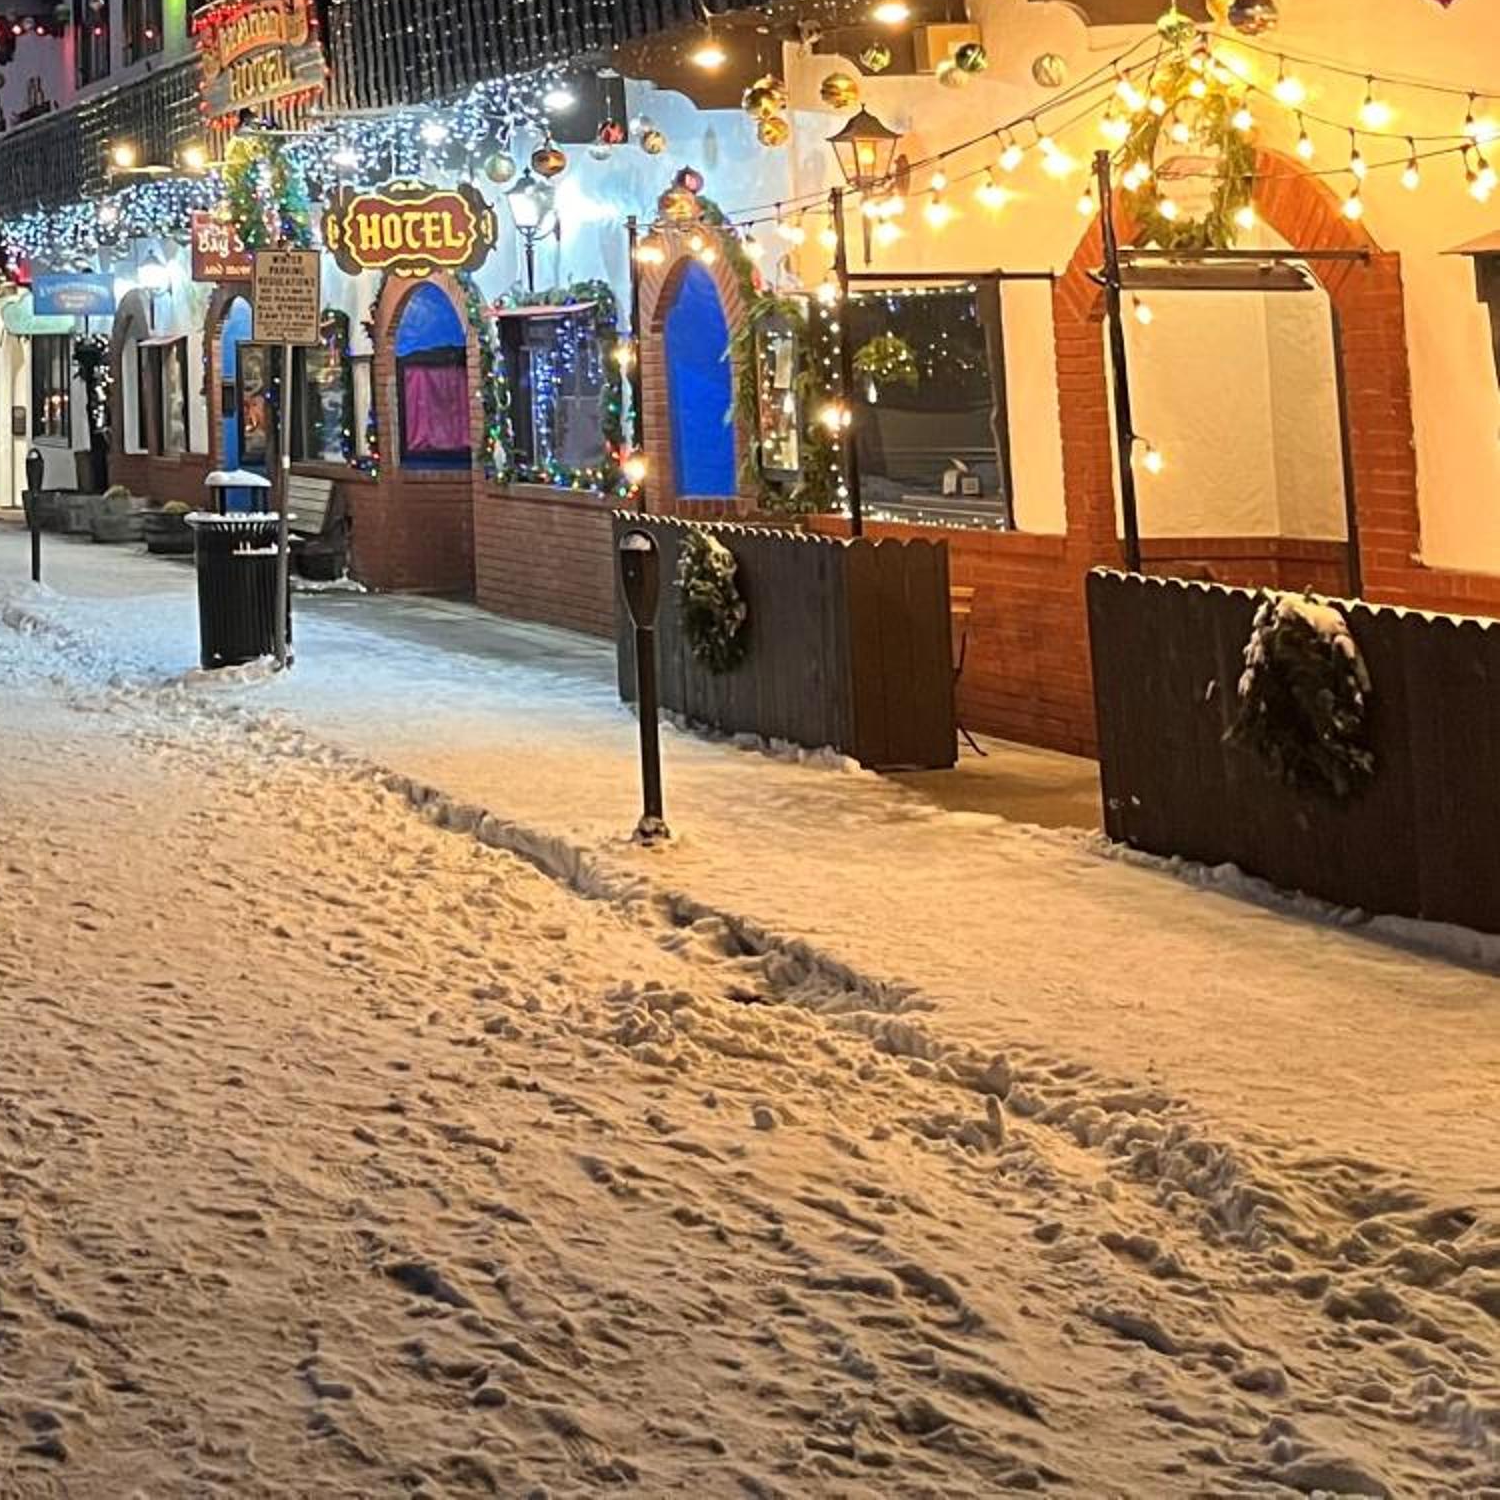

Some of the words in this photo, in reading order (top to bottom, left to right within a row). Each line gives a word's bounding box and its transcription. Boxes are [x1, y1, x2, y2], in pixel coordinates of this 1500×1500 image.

[230, 49, 292, 101] HOTEL
[355, 210, 466, 251] HOTEL
[269, 266, 305, 276] PARKING
[272, 255, 303, 265] WINTER
